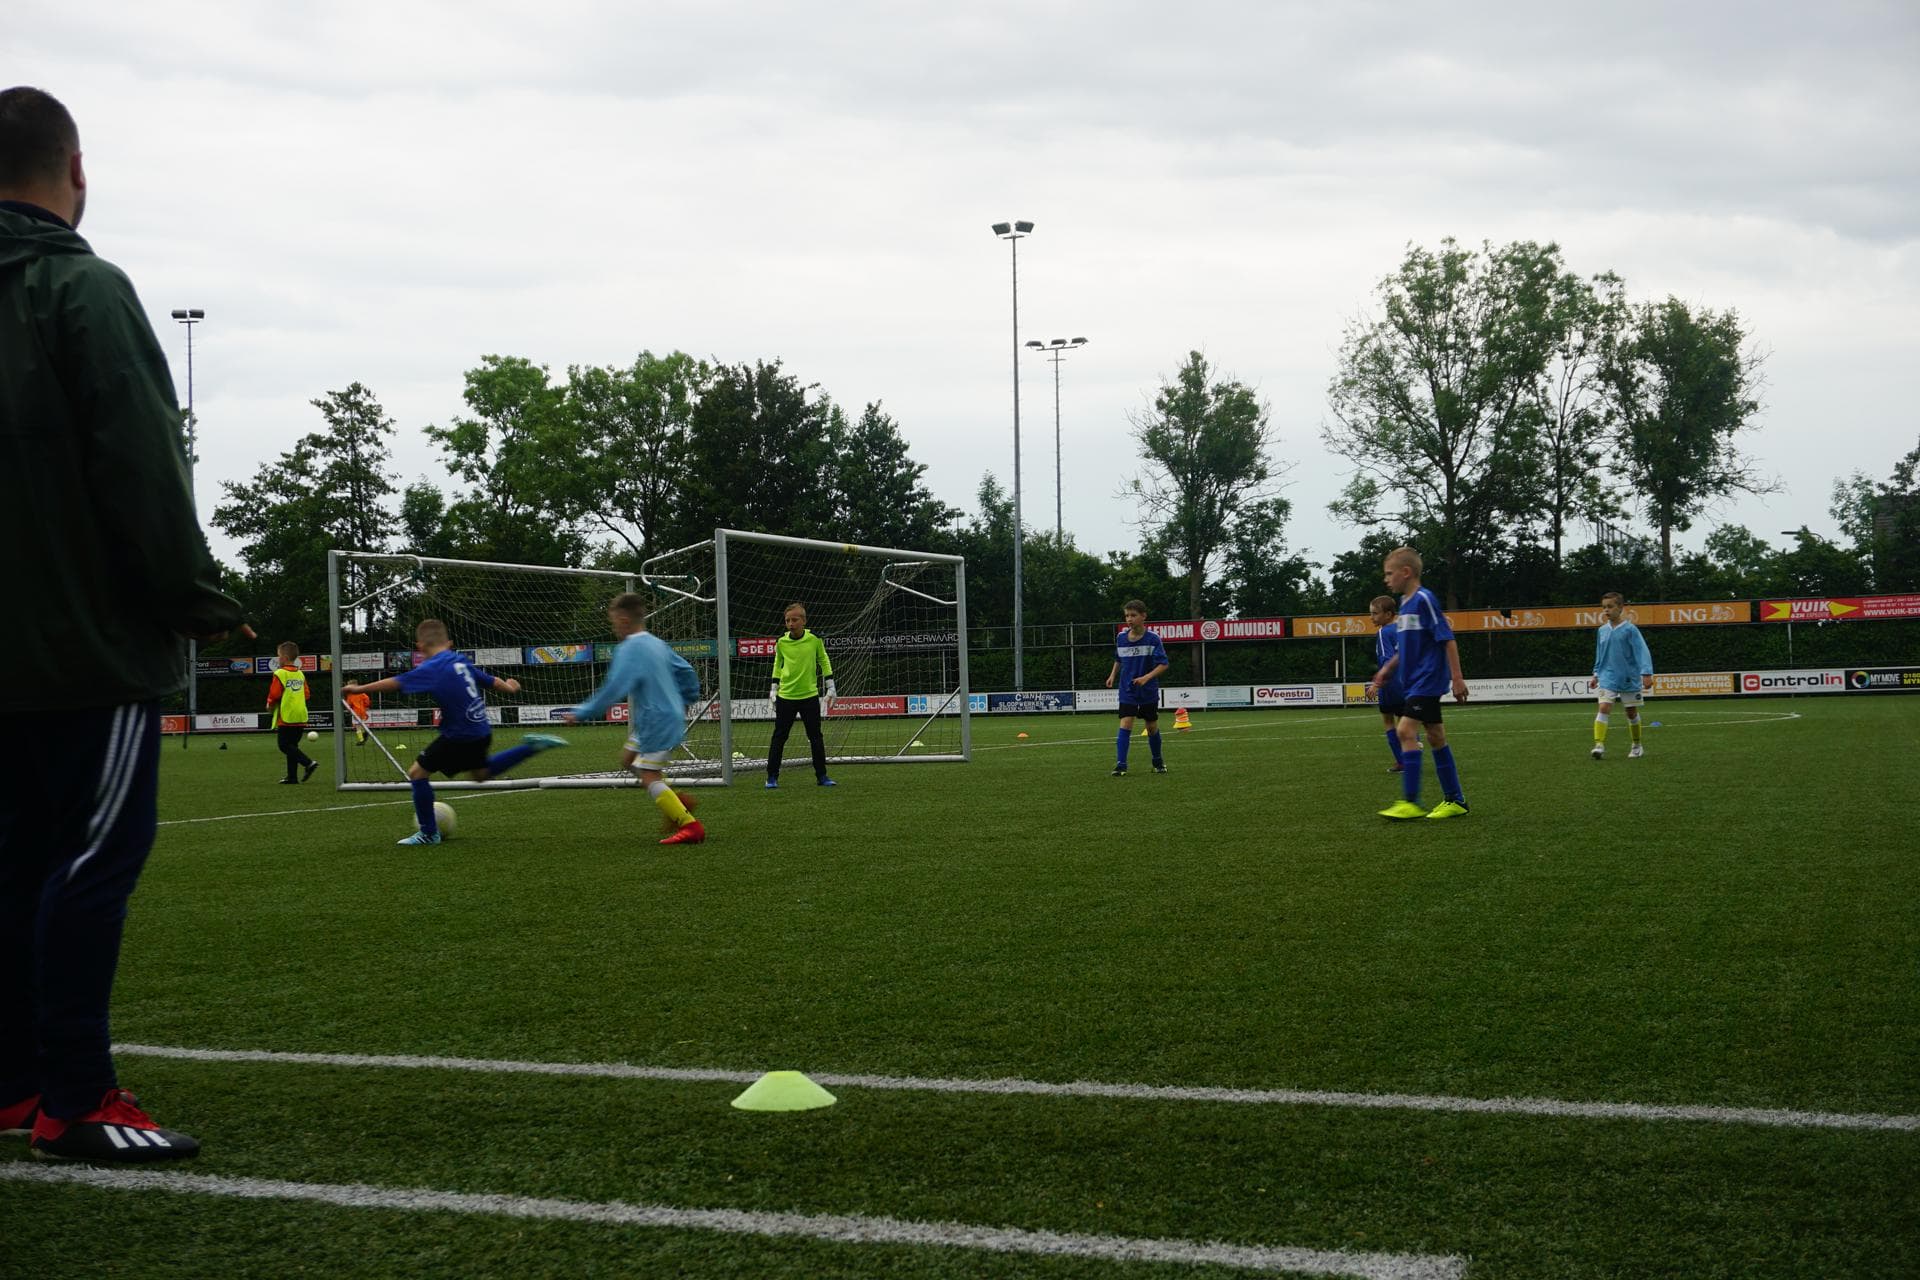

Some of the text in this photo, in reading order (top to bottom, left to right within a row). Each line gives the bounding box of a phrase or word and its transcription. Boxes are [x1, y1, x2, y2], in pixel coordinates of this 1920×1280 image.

[1791, 601, 1831, 613] VUIK
[1483, 614, 1520, 628] ING
[1669, 608, 1707, 623] ING
[1224, 620, 1281, 637] IJMUIDEN
[1307, 621, 1341, 635] ING
[750, 645, 764, 654] DE
[453, 662, 478, 698] 3
[213, 715, 246, 724] Arie Kok
